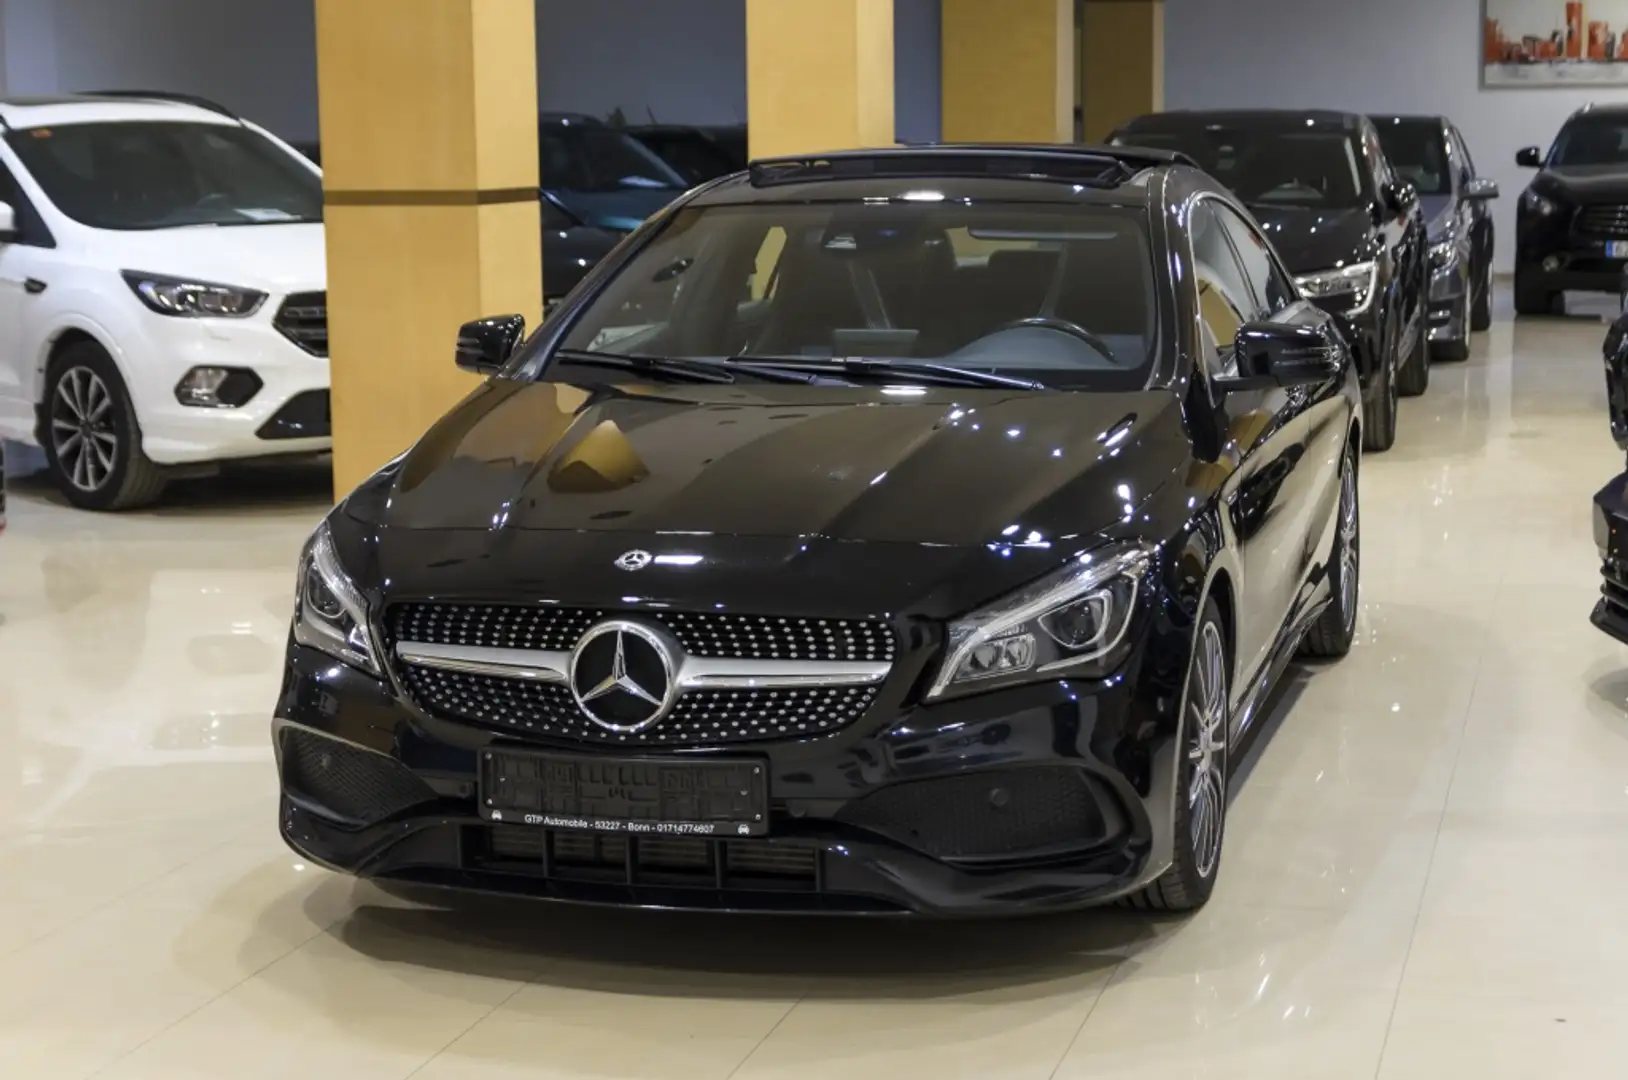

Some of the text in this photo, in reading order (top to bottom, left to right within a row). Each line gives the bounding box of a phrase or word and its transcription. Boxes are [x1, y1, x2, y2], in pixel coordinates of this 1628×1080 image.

[524, 814, 543, 824] GTP
[544, 816, 588, 828] Automobile
[595, 820, 621, 830] 53227
[628, 822, 650, 832] Bonn
